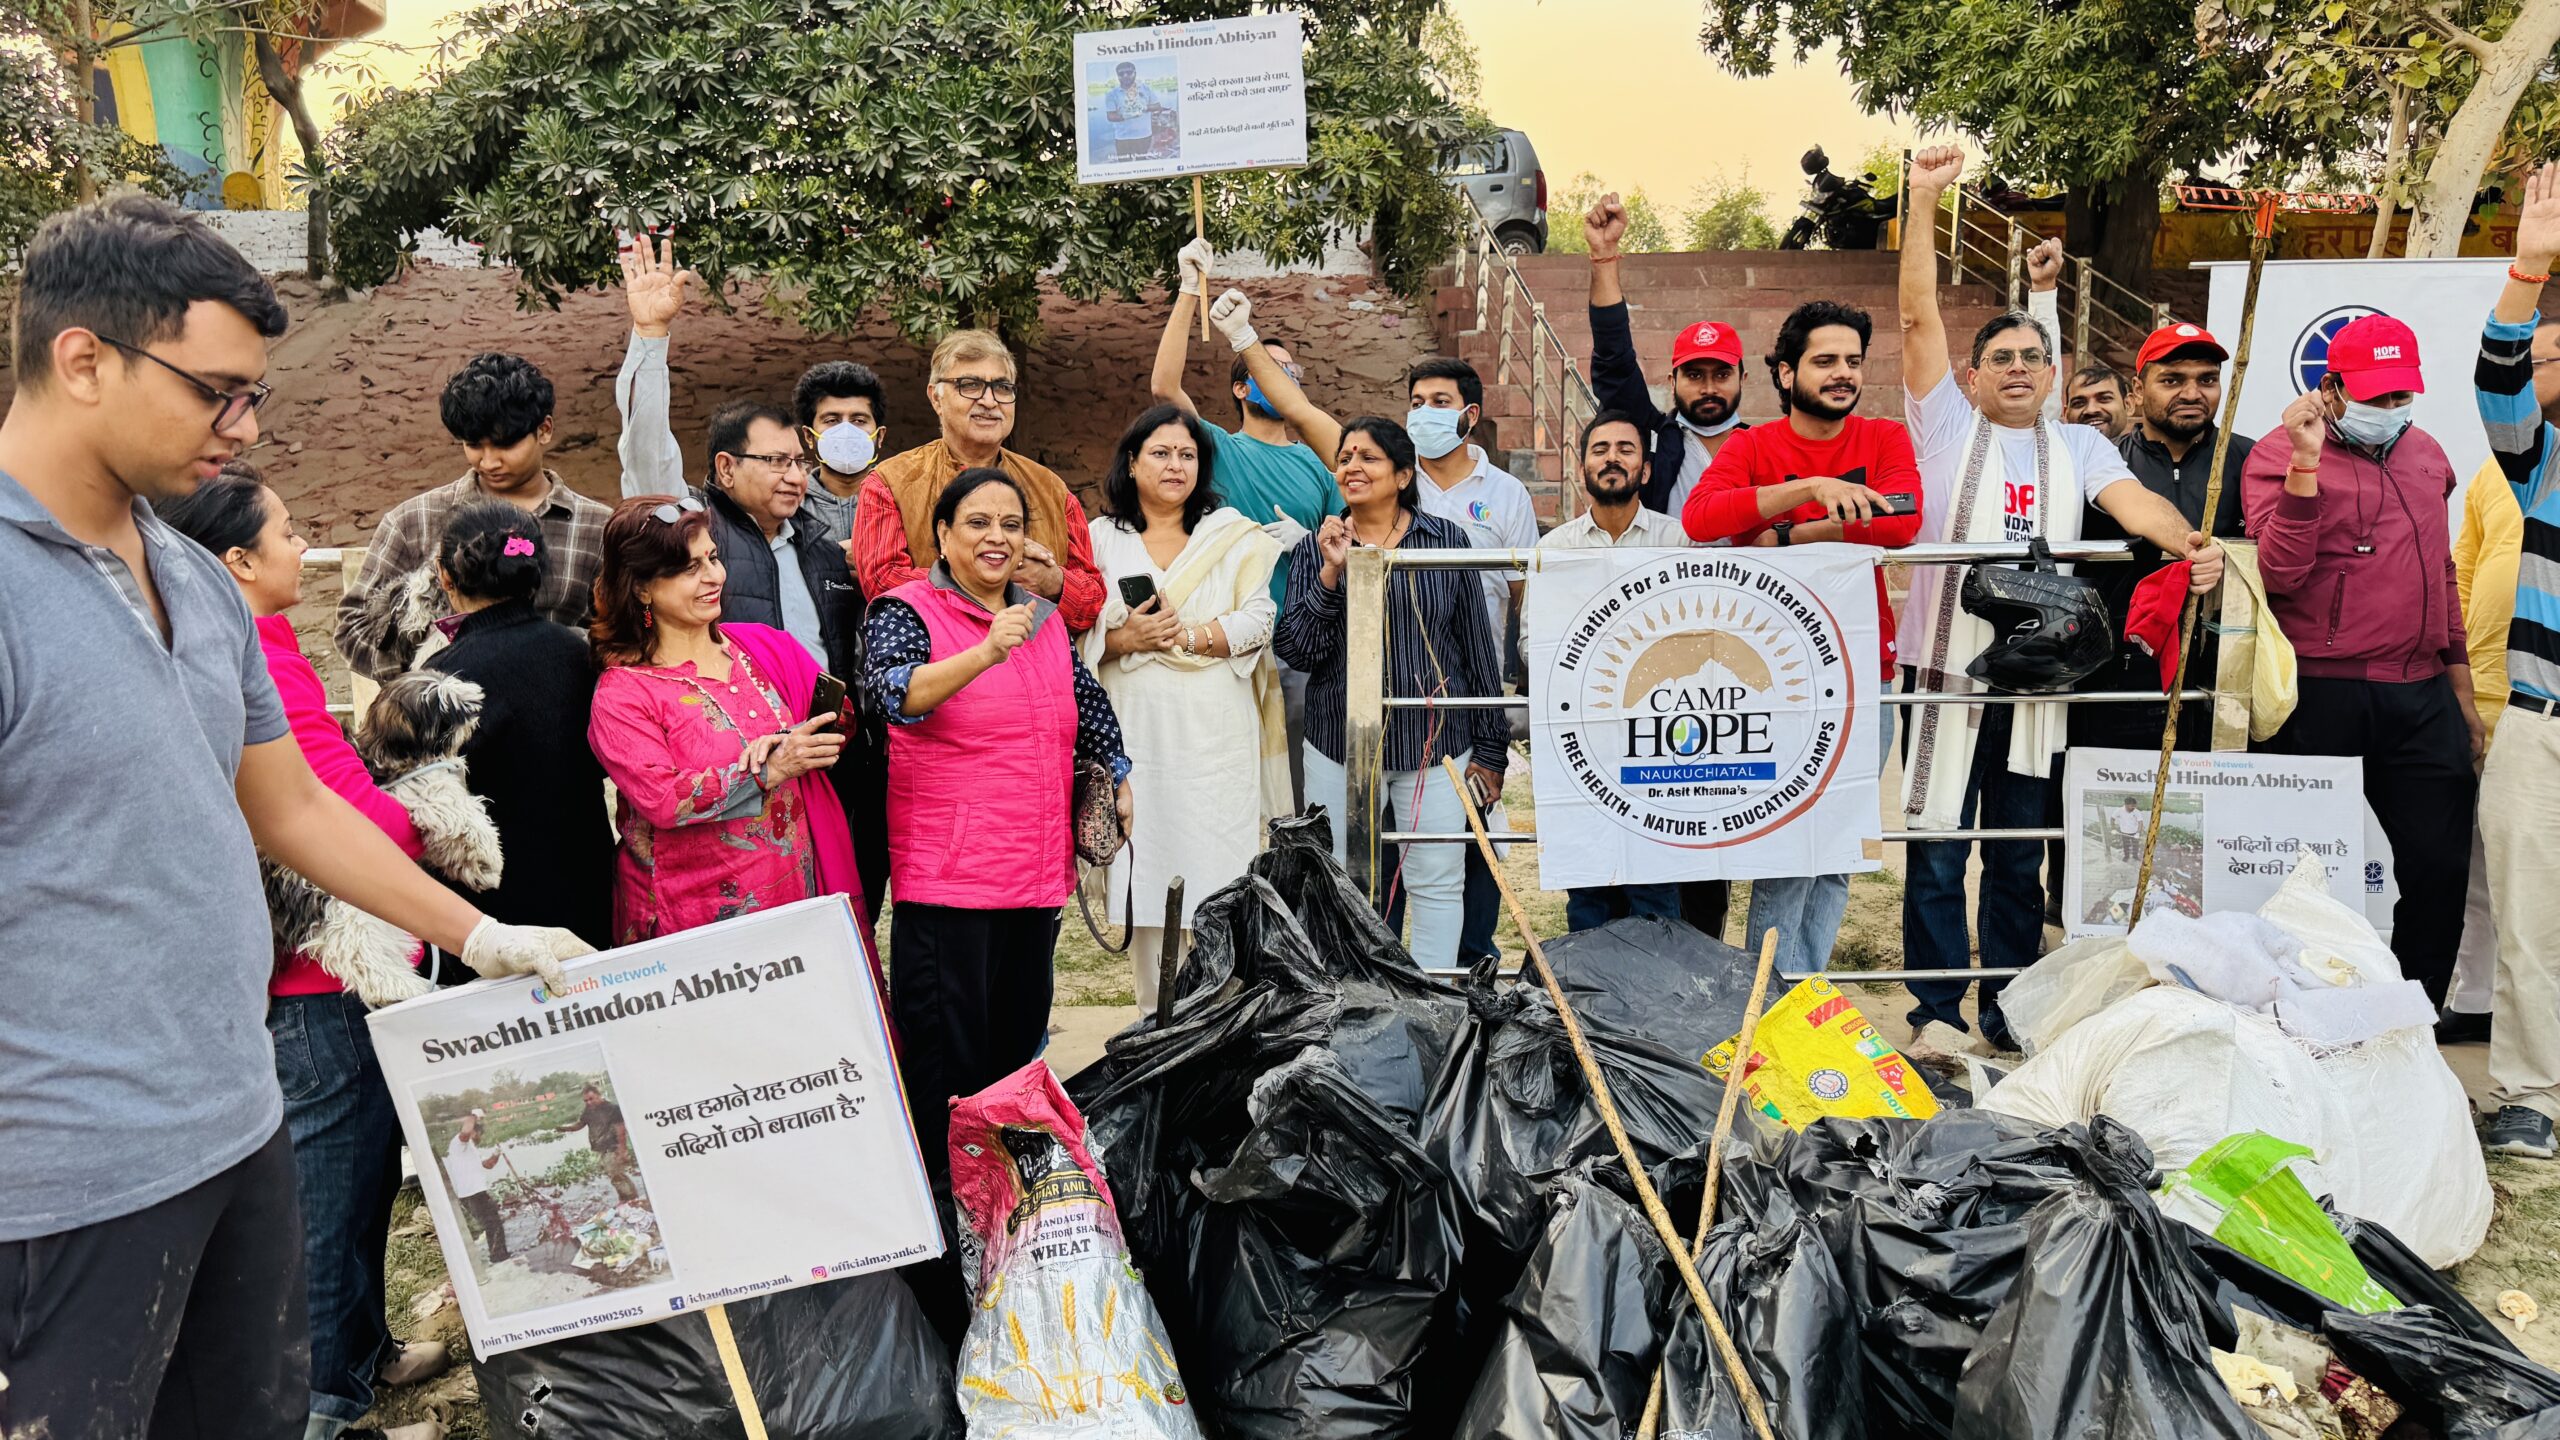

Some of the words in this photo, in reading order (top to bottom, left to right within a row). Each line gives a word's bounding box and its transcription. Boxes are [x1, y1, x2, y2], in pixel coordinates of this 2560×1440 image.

[1097, 40, 1154, 56] Swachh
[1158, 34, 1213, 50] Hindon
[1215, 29, 1277, 45] Abhiyan
[2373, 345, 2401, 357] HOPE
[1559, 598, 1621, 671] Initiative
[1620, 576, 1652, 601] For
[1658, 570, 1670, 585] a
[1676, 560, 1752, 587] Healthy
[1756, 572, 1839, 667] Uttarakhand
[1650, 687, 1747, 713] CAMP
[1623, 712, 1774, 758] HOPE
[1640, 766, 1756, 781] NAUKUCHIATAL
[2184, 758, 2212, 768] Youth
[2213, 759, 2255, 769] Network
[1560, 731, 1588, 772] FREE
[1580, 769, 1632, 817] HEALTH
[1643, 813, 1707, 836] NATURE
[1722, 775, 1809, 832] EDUCATION
[1803, 720, 1836, 777] CAMPS
[2176, 770, 2249, 787] Hindon
[2251, 773, 2333, 792] Abhiyan
[1648, 788, 1664, 798] Dr.
[1667, 786, 1690, 797] Asit
[2335, 838, 2349, 856] है
[2228, 857, 2255, 875] देश
[2259, 859, 2284, 876] की
[564, 976, 600, 996] outh
[600, 960, 668, 988] Network
[422, 1015, 543, 1064] Swachh
[544, 987, 667, 1035] Hindon
[670, 952, 806, 1008] Abhiyan
[694, 1083, 750, 1119] हमने
[752, 1080, 787, 1102] यह
[787, 1068, 839, 1094] ठाना
[661, 1124, 728, 1159] नदियों
[729, 1115, 765, 1143] को
[766, 1103, 836, 1135] बचाना
[1062, 1180, 1088, 1192] ANIL
[1040, 1227, 1073, 1241] SEHORI
[1030, 1238, 1091, 1263] WHEAT
[481, 1336, 501, 1349] Join
[502, 1331, 523, 1344] The
[524, 1320, 579, 1339] Movement
[580, 1305, 644, 1327] 9350025025
